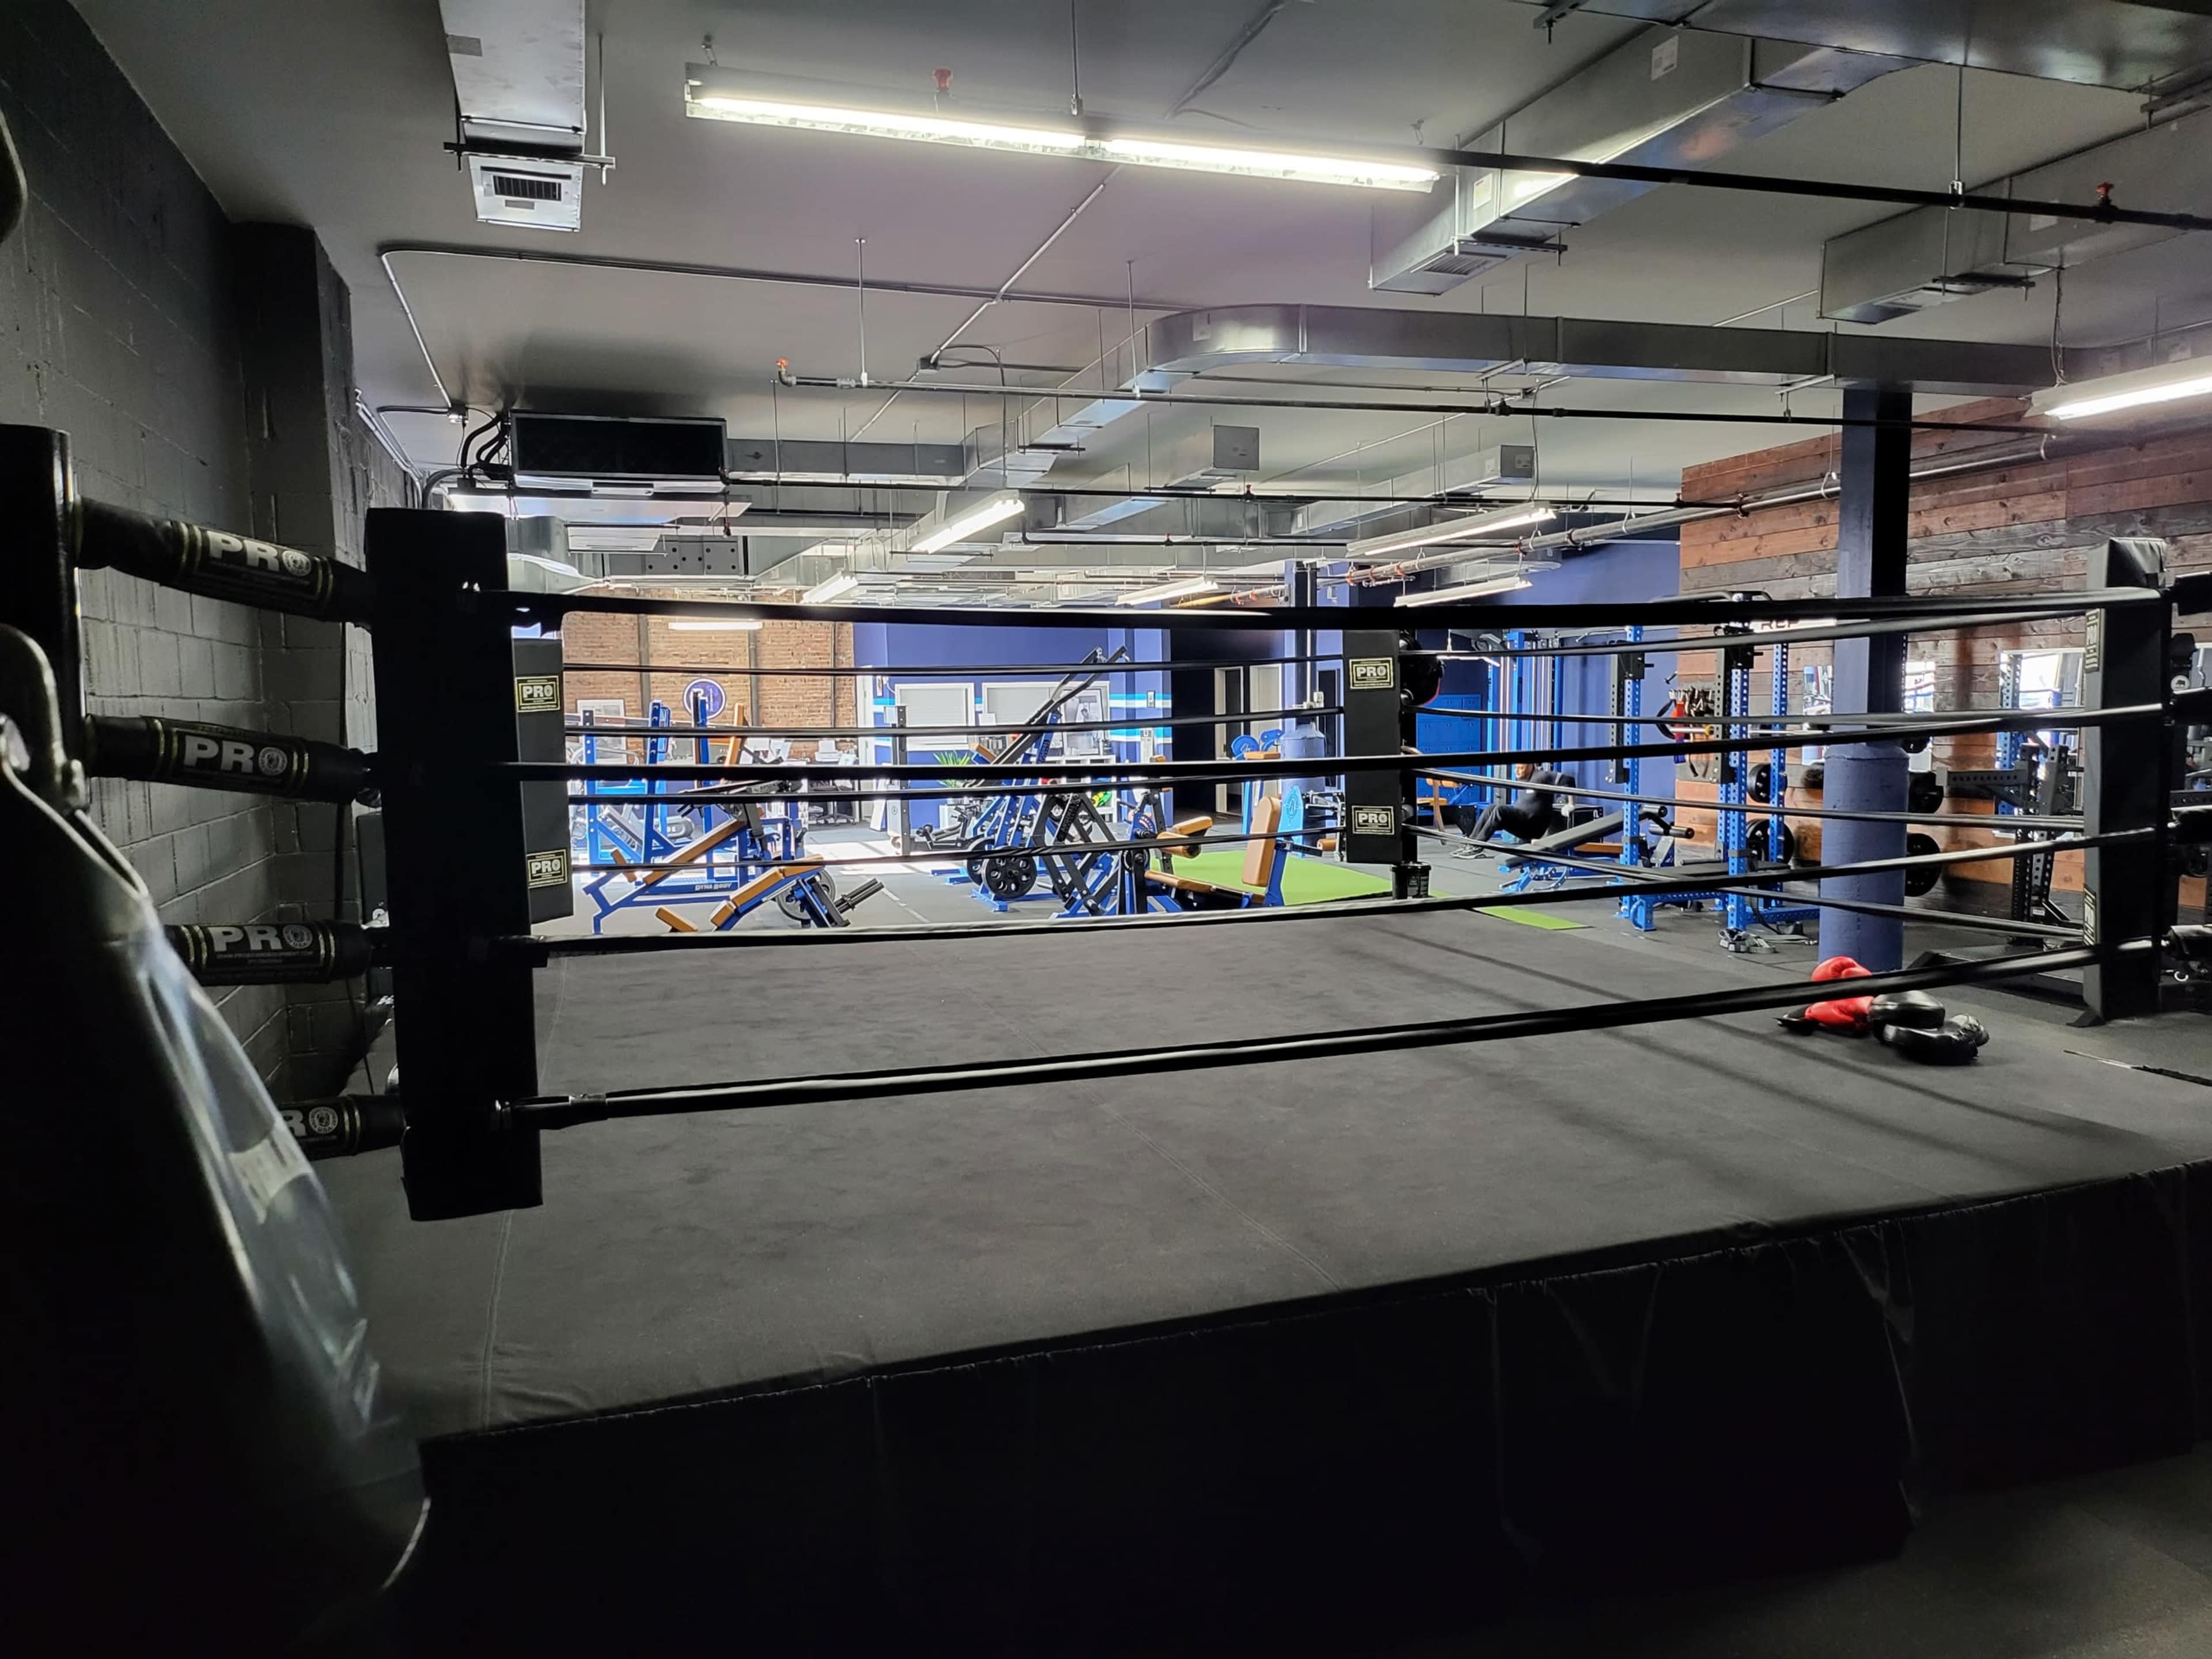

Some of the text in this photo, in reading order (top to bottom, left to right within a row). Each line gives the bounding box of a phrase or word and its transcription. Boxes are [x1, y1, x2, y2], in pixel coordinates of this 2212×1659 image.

[206, 531, 312, 576] PRO
[1356, 665, 1387, 677] PRO
[522, 684, 553, 699] PRO
[183, 734, 288, 775] PRO
[1358, 813, 1388, 823] PRO
[531, 859, 560, 874] PRO
[208, 925, 313, 952] PRO
[281, 1107, 338, 1137] RO
